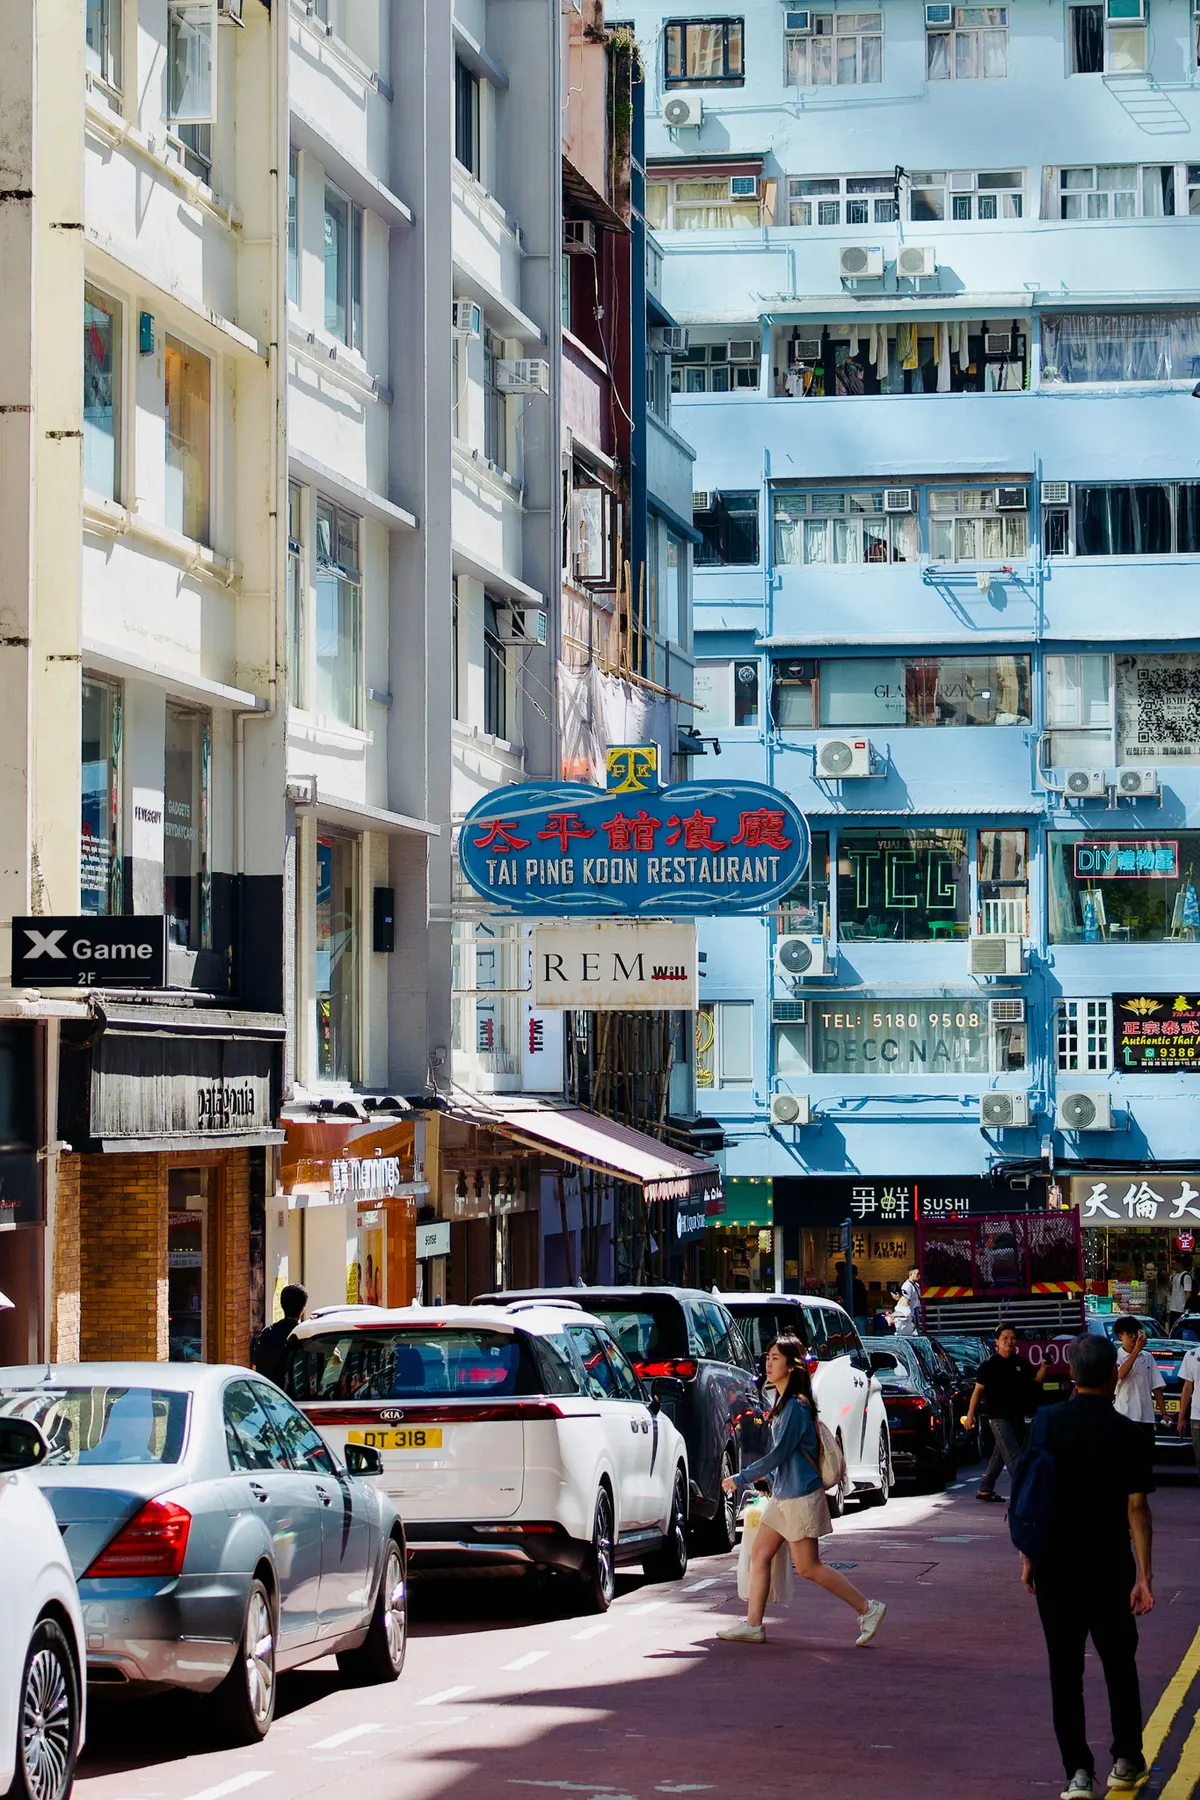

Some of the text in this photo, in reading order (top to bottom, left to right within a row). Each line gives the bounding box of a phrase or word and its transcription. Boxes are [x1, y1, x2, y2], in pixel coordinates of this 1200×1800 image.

[486, 856, 780, 885] TAI PING KOON RESTAURANT
[23, 930, 153, 960] X Game
[543, 953, 647, 982] REM
[78, 972, 96, 985] 2F
[822, 1013, 979, 1028] TEL: 5180 9508
[1122, 1020, 1199, 1035] 正宗泰式
[1121, 1035, 1171, 1046] Authentic
[1172, 1035, 1194, 1045] Thai
[822, 1038, 899, 1063] DECO
[1160, 1047, 1195, 1058] 9386
[197, 1080, 255, 1126] patagonia
[350, 1156, 400, 1197] mannings
[923, 1198, 969, 1211] SUSHI
[1082, 1181, 1200, 1219] 天倫大
[874, 1241, 907, 1251] SUSHI
[383, 1410, 400, 1419] KIA
[364, 1431, 426, 1447] DT 318
